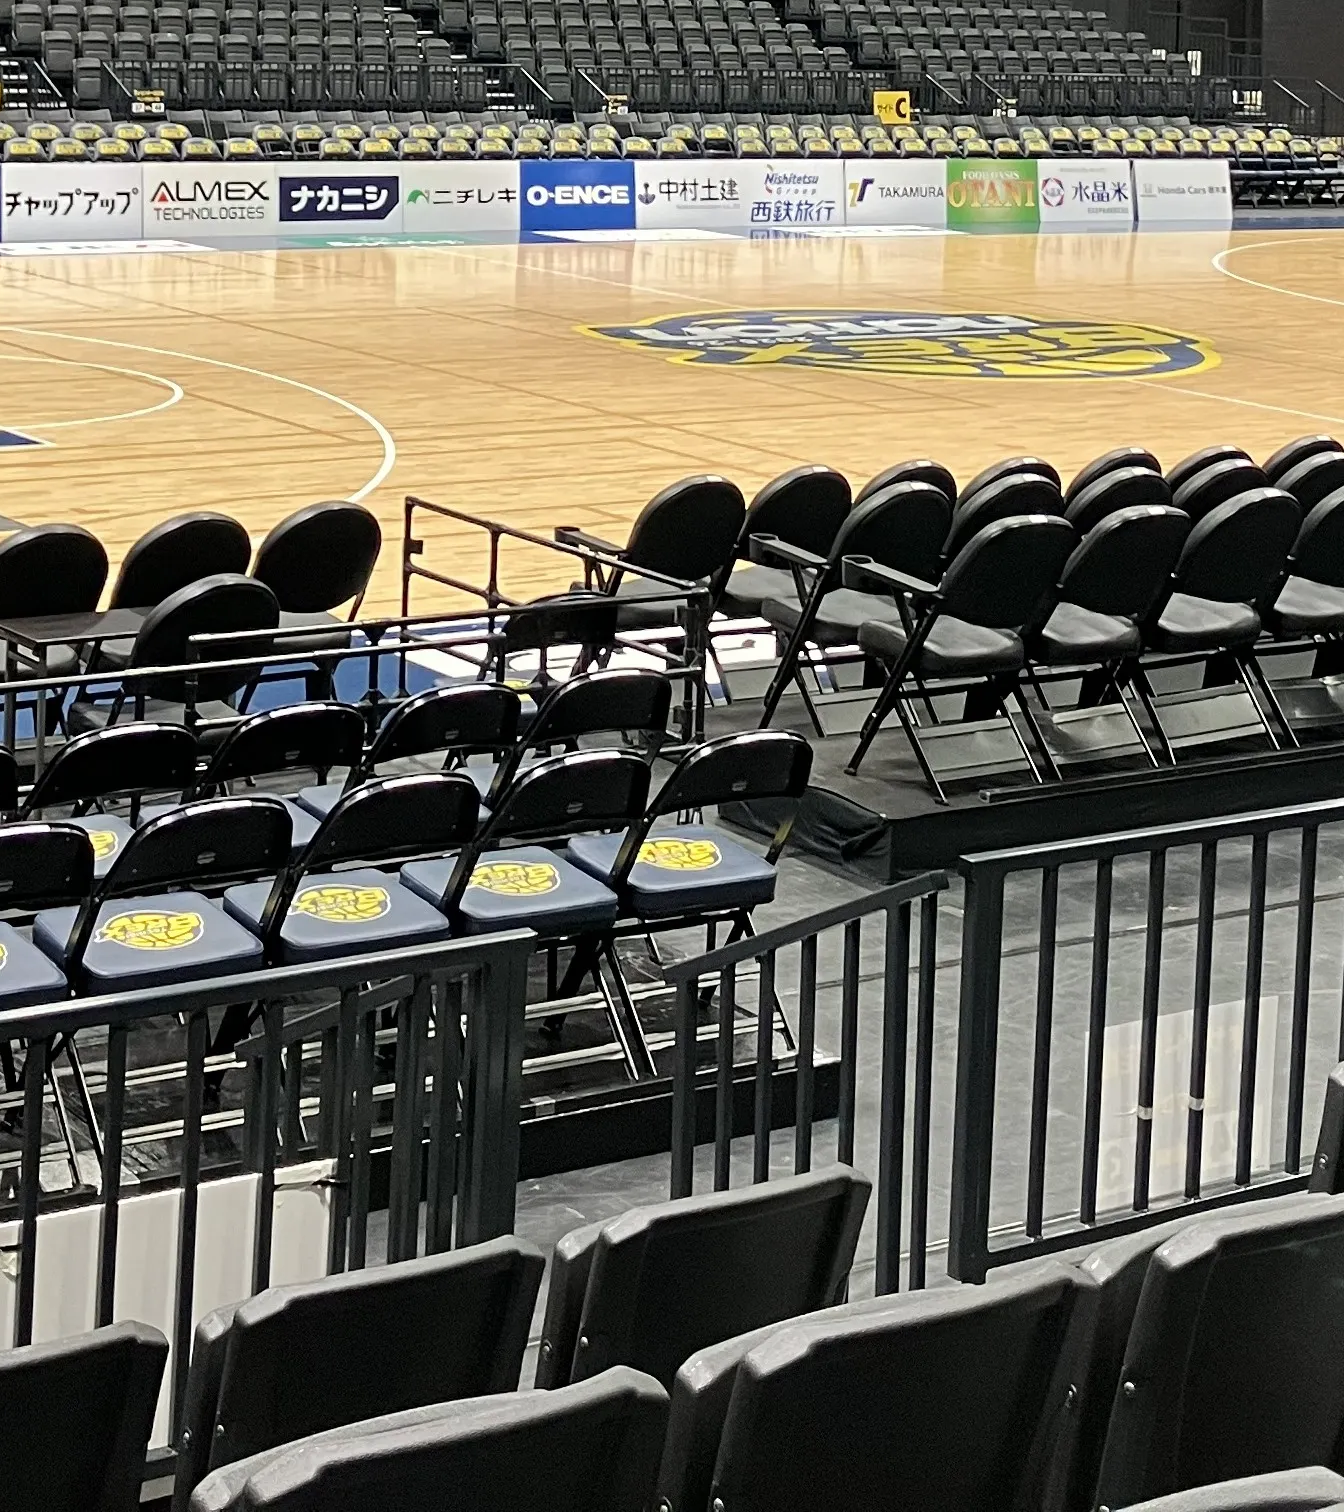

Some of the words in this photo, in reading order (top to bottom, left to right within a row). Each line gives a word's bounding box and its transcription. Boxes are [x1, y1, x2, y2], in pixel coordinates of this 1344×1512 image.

[895, 97, 907, 118] C
[659, 178, 739, 201] 中村土建
[766, 173, 819, 185] Nishitetsu
[151, 181, 269, 202] ALMEX
[290, 187, 389, 213] ナカニシ
[433, 189, 516, 207] ニチレキ
[879, 187, 944, 198] TAKAMURA
[948, 181, 1035, 208] OTANI
[1072, 182, 1129, 203] 水晶米
[4, 188, 139, 217] チャップアップ
[751, 200, 835, 222] 西鉄旅行
[154, 206, 265, 221] TECHNOLOGIES
[704, 325, 1181, 365] BREX
